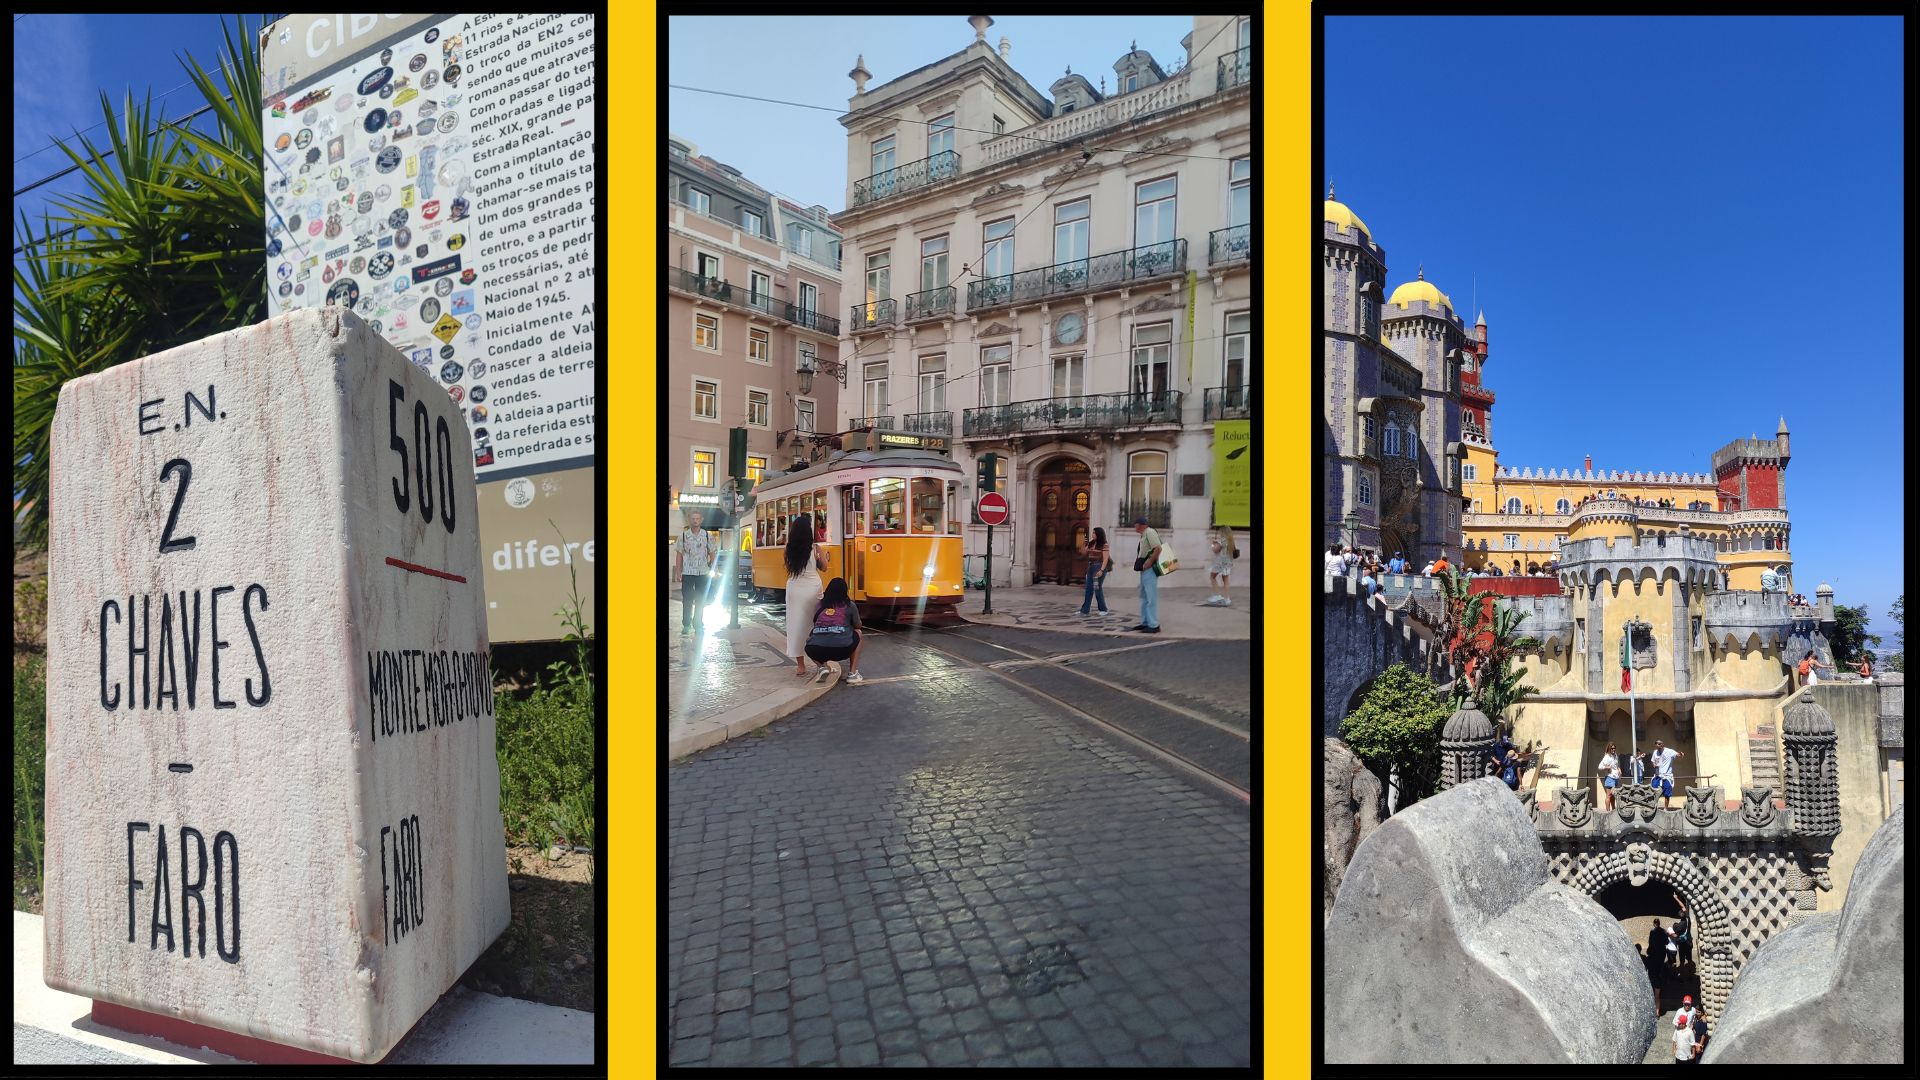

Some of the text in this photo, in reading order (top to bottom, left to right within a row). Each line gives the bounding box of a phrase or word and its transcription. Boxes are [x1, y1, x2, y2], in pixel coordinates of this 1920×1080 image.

[306, 14, 401, 58] CIB
[463, 21, 471, 32] A
[465, 33, 476, 44] 11
[481, 22, 503, 38] rios
[507, 17, 513, 25] e
[465, 14, 566, 59] Estrada Naciona
[466, 64, 474, 74] O
[480, 49, 511, 68] troço
[517, 39, 531, 52] da
[538, 24, 564, 42] EN2
[468, 67, 502, 89] sendo
[506, 57, 527, 72] que
[531, 36, 574, 61] muitos
[469, 75, 520, 104] romanas
[522, 65, 545, 82] que
[470, 102, 496, 118] Com
[499, 98, 506, 106] o
[510, 78, 551, 104] passar
[555, 71, 570, 83] do
[471, 76, 594, 133] melhoradas e ligad
[472, 133, 495, 148] séc.
[500, 122, 522, 138] XIX,
[527, 103, 571, 128] grande
[473, 126, 554, 162] Estrada Real.
[474, 163, 500, 179] Com
[512, 130, 591, 166] implantação
[476, 149, 585, 196] ganha o título de
[477, 181, 543, 210] chamar-se
[546, 168, 577, 187] mais
[478, 213, 498, 225] Um
[502, 204, 524, 218] dos
[528, 184, 581, 211] grandes
[480, 231, 494, 241] de
[500, 220, 526, 235] uma
[533, 201, 582, 224] estrada
[481, 239, 524, 256] centro,
[528, 234, 534, 242] e
[538, 231, 545, 239] a
[549, 214, 586, 238] partir
[482, 232, 594, 272] os troços de pedr
[484, 261, 563, 289] necessárias,
[568, 248, 589, 264] até
[485, 282, 539, 305] Nacional
[565, 272, 572, 283] 2
[486, 291, 570, 321] Maio de 1945.
[486, 311, 573, 340] Inicialmente
[488, 335, 542, 356] Condado
[550, 330, 566, 341] de
[490, 356, 532, 374] nascer
[552, 342, 593, 358] aldeia
[491, 360, 594, 390] vendas de terre
[493, 389, 541, 406] condes.
[494, 414, 502, 424] A
[505, 406, 544, 422] aldeia
[547, 405, 554, 413] a
[496, 430, 510, 441] da
[513, 420, 566, 438] referida
[498, 437, 572, 458] empedrada
[575, 436, 582, 444] e
[585, 434, 594, 443] s
[881, 435, 944, 448] PRAZERES 28
[389, 378, 456, 534] 500
[159, 458, 196, 553] 2
[99, 583, 272, 711] CHAVES
[127, 821, 241, 965] FARO
[380, 814, 424, 946] FARO
